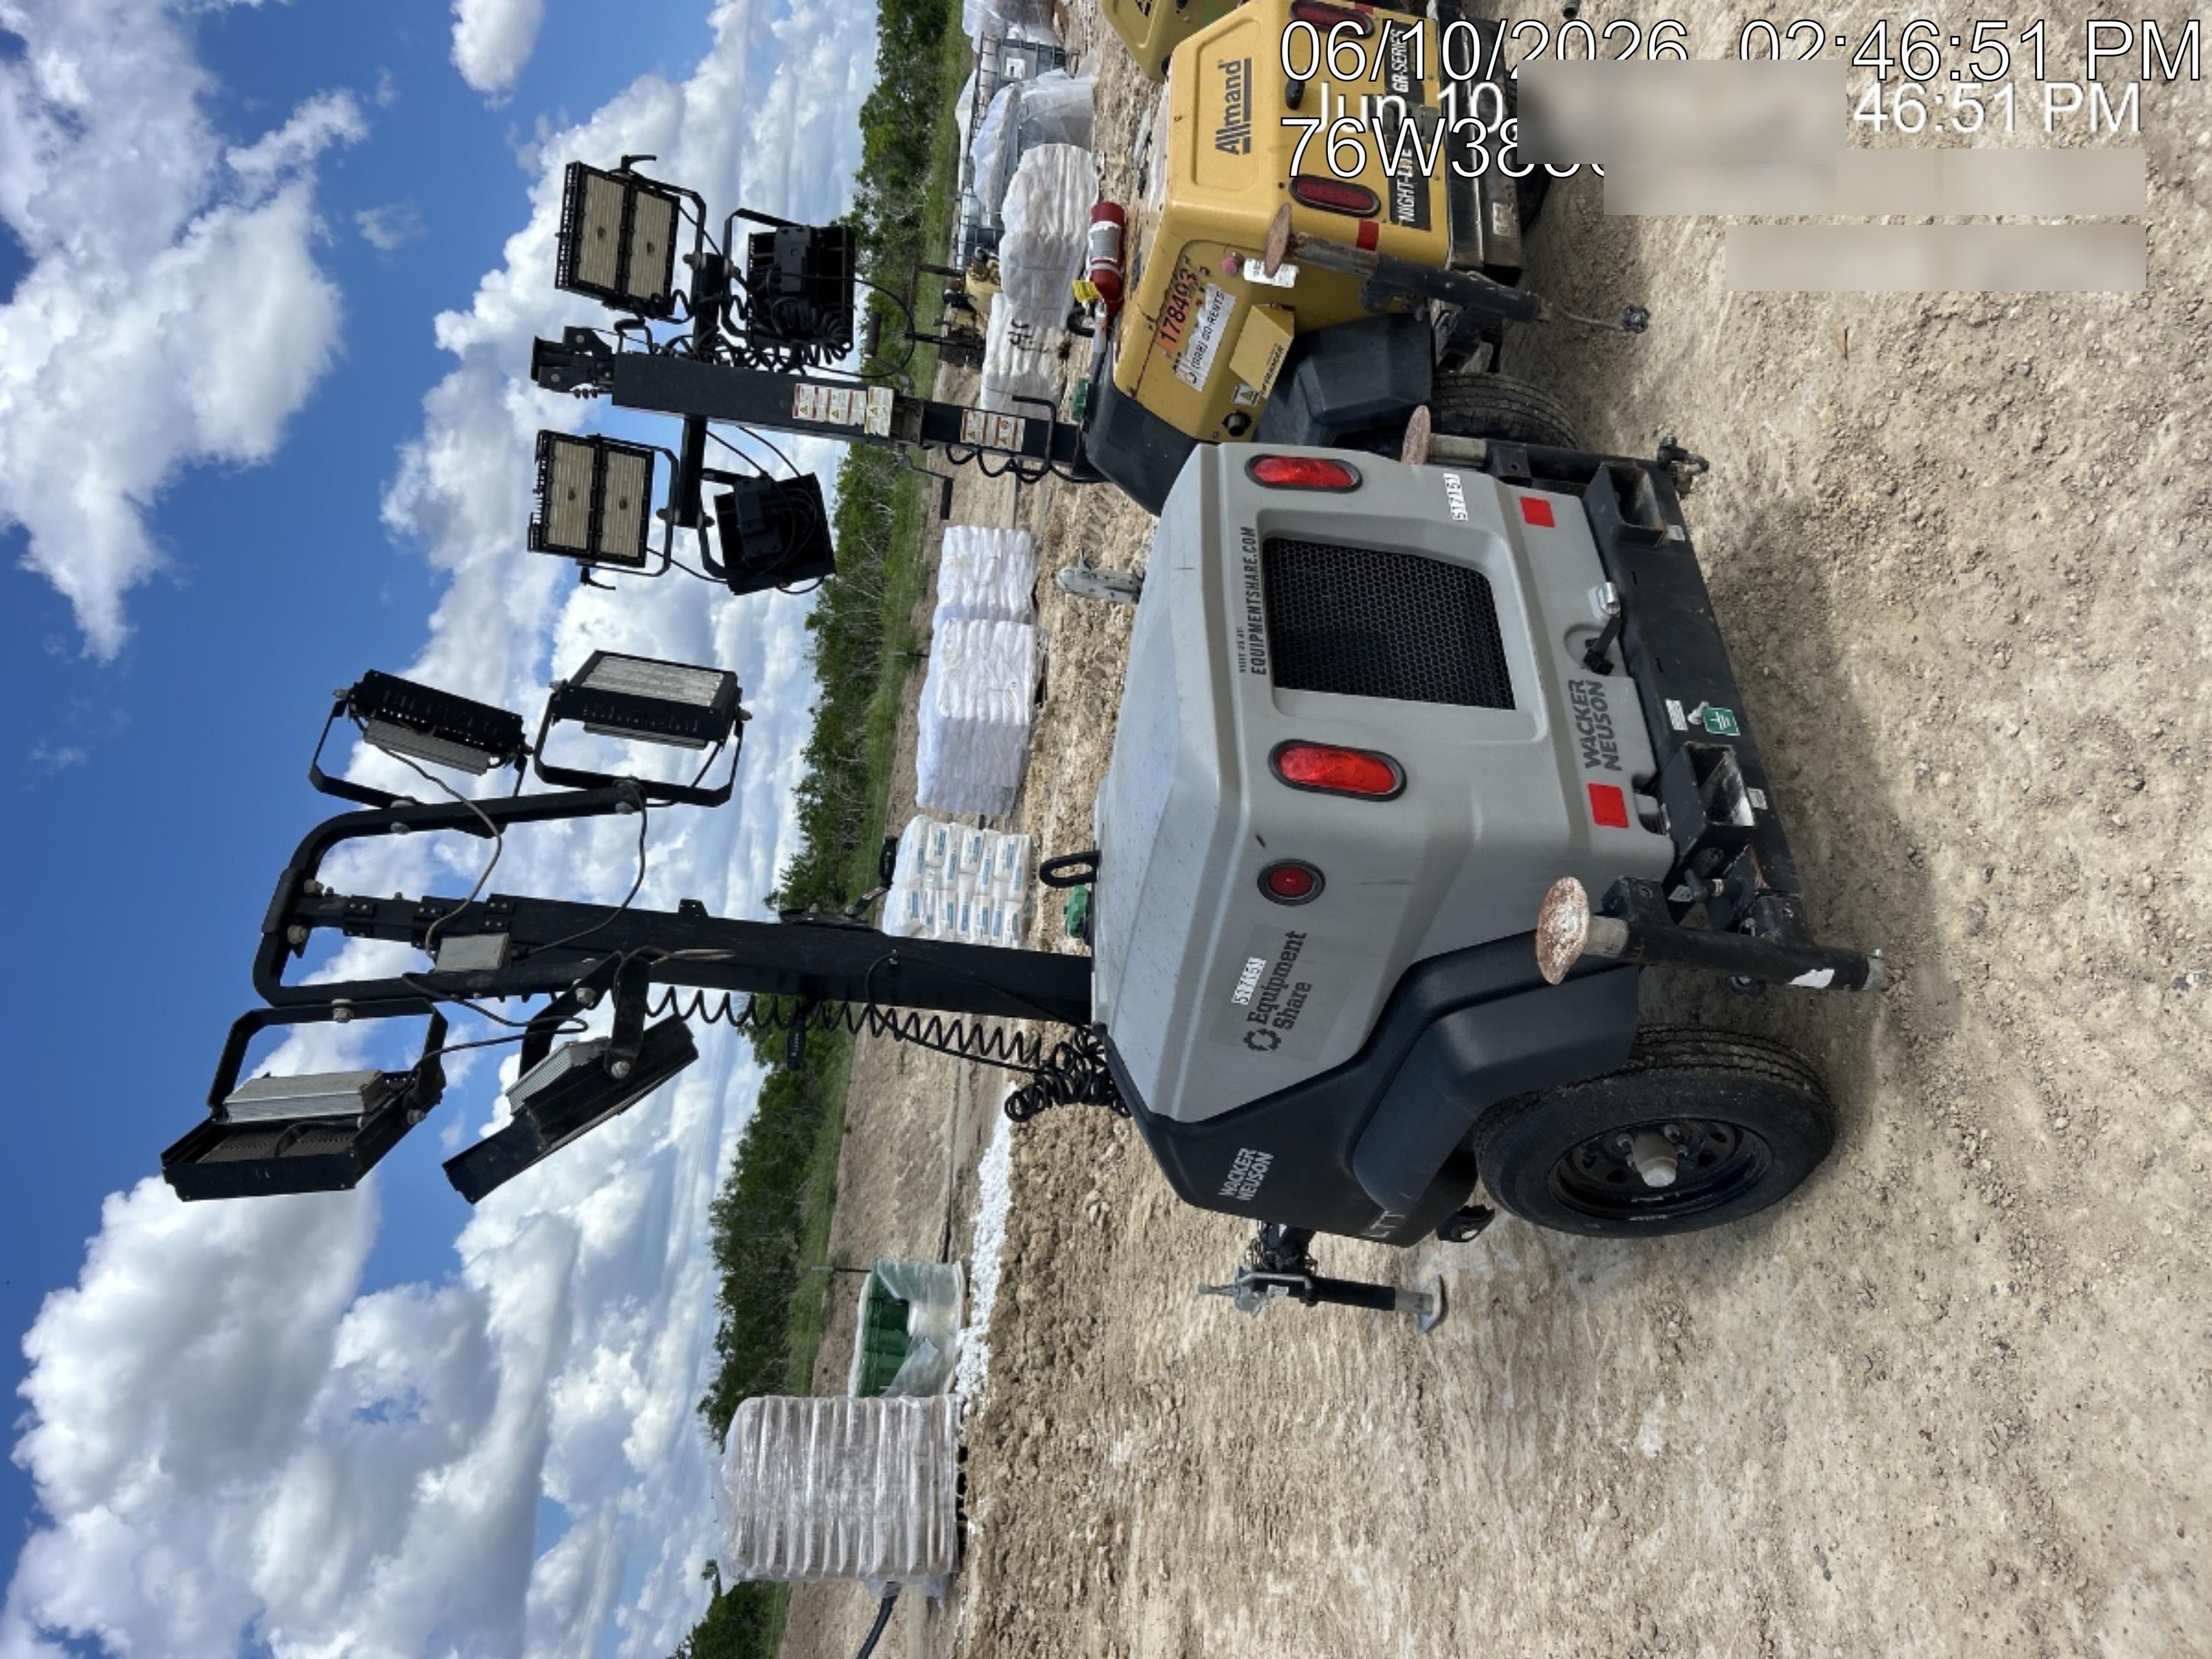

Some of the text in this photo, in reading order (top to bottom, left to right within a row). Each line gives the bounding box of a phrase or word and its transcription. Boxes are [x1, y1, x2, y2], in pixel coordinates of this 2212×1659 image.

[1214, 60, 1251, 155] Allmand
[1240, 527, 1267, 675] EQUIPMENTSHARE.COM
[1567, 680, 1602, 769] WACKER
[1585, 680, 1622, 771] NEUSON
[1245, 930, 1307, 1026] Equipment
[1273, 982, 1311, 1030] Share
[1218, 1147, 1258, 1196] WACKER
[1236, 1151, 1274, 1201] NEUSON
